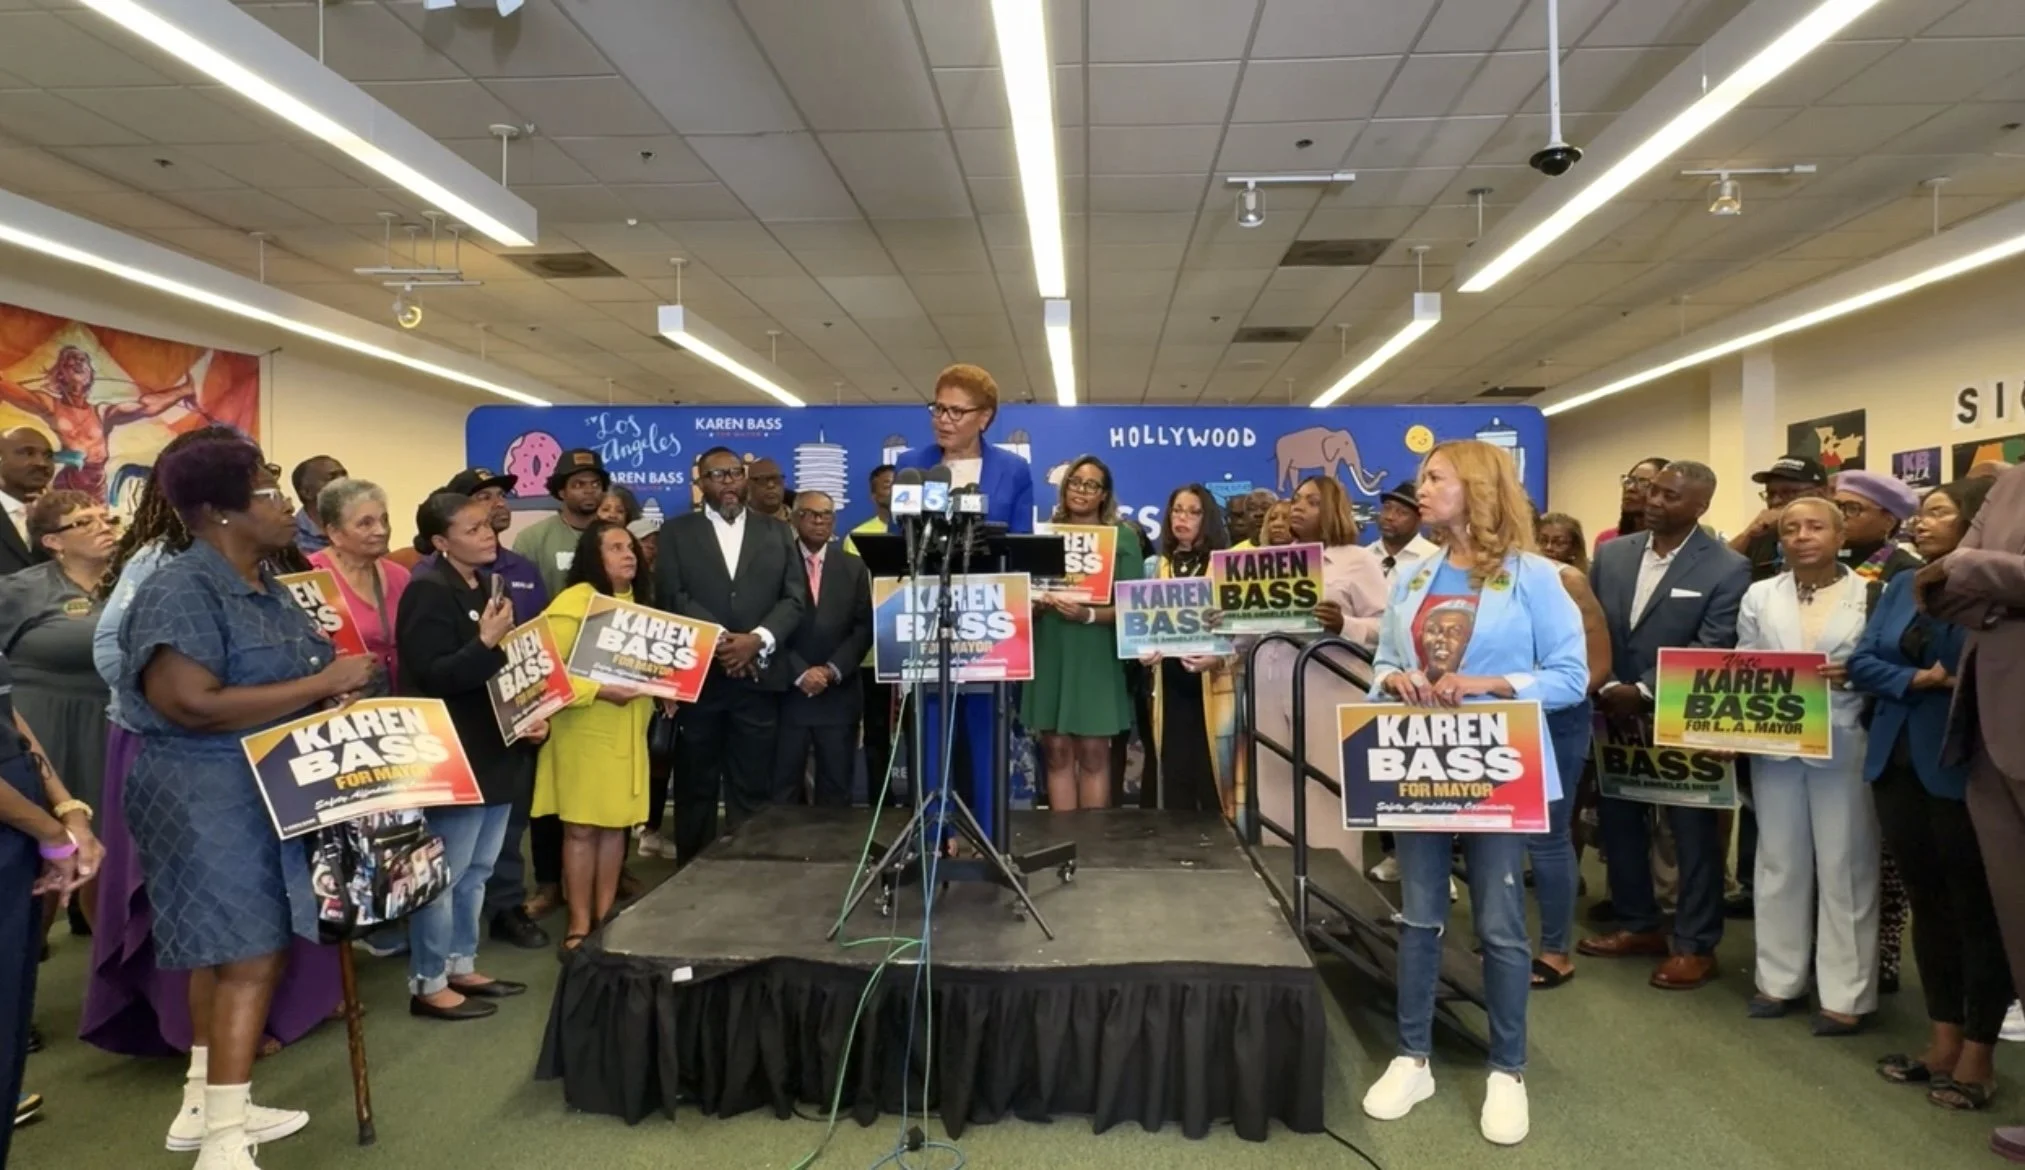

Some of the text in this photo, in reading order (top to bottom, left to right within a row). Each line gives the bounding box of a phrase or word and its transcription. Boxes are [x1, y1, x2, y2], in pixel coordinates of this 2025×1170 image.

[1957, 379, 2025, 424] SI
[596, 412, 641, 440] Los
[695, 417, 783, 430] KAREN BASS
[1109, 425, 1256, 447] HOLLYWOOD
[589, 422, 682, 468] Angeles
[609, 471, 685, 484] AREN BASS
[894, 490, 910, 503] 4
[924, 487, 942, 511] 5
[1065, 552, 1103, 575] SS
[1225, 550, 1309, 582] KAREN
[1130, 582, 1213, 611] KAREN
[1219, 579, 1318, 611] BASS
[611, 608, 699, 647] KAREN
[596, 626, 699, 671] BASS
[1722, 653, 1762, 669] Vote
[498, 649, 555, 703] BASS
[612, 654, 634, 667] FOR
[635, 658, 674, 678] MAYOR
[1693, 668, 1795, 694] KAREN
[1684, 694, 1805, 722] BASS
[291, 707, 429, 754] KAREN
[1377, 712, 1509, 746] KAREN
[1685, 720, 1711, 733] FOR
[1754, 722, 1803, 735] MAYOR
[288, 733, 449, 787] BASS
[1368, 747, 1525, 782] BASS
[1602, 745, 1725, 782] BASS
[335, 770, 373, 790] FOR
[1400, 783, 1494, 798] FOR MAYOR
